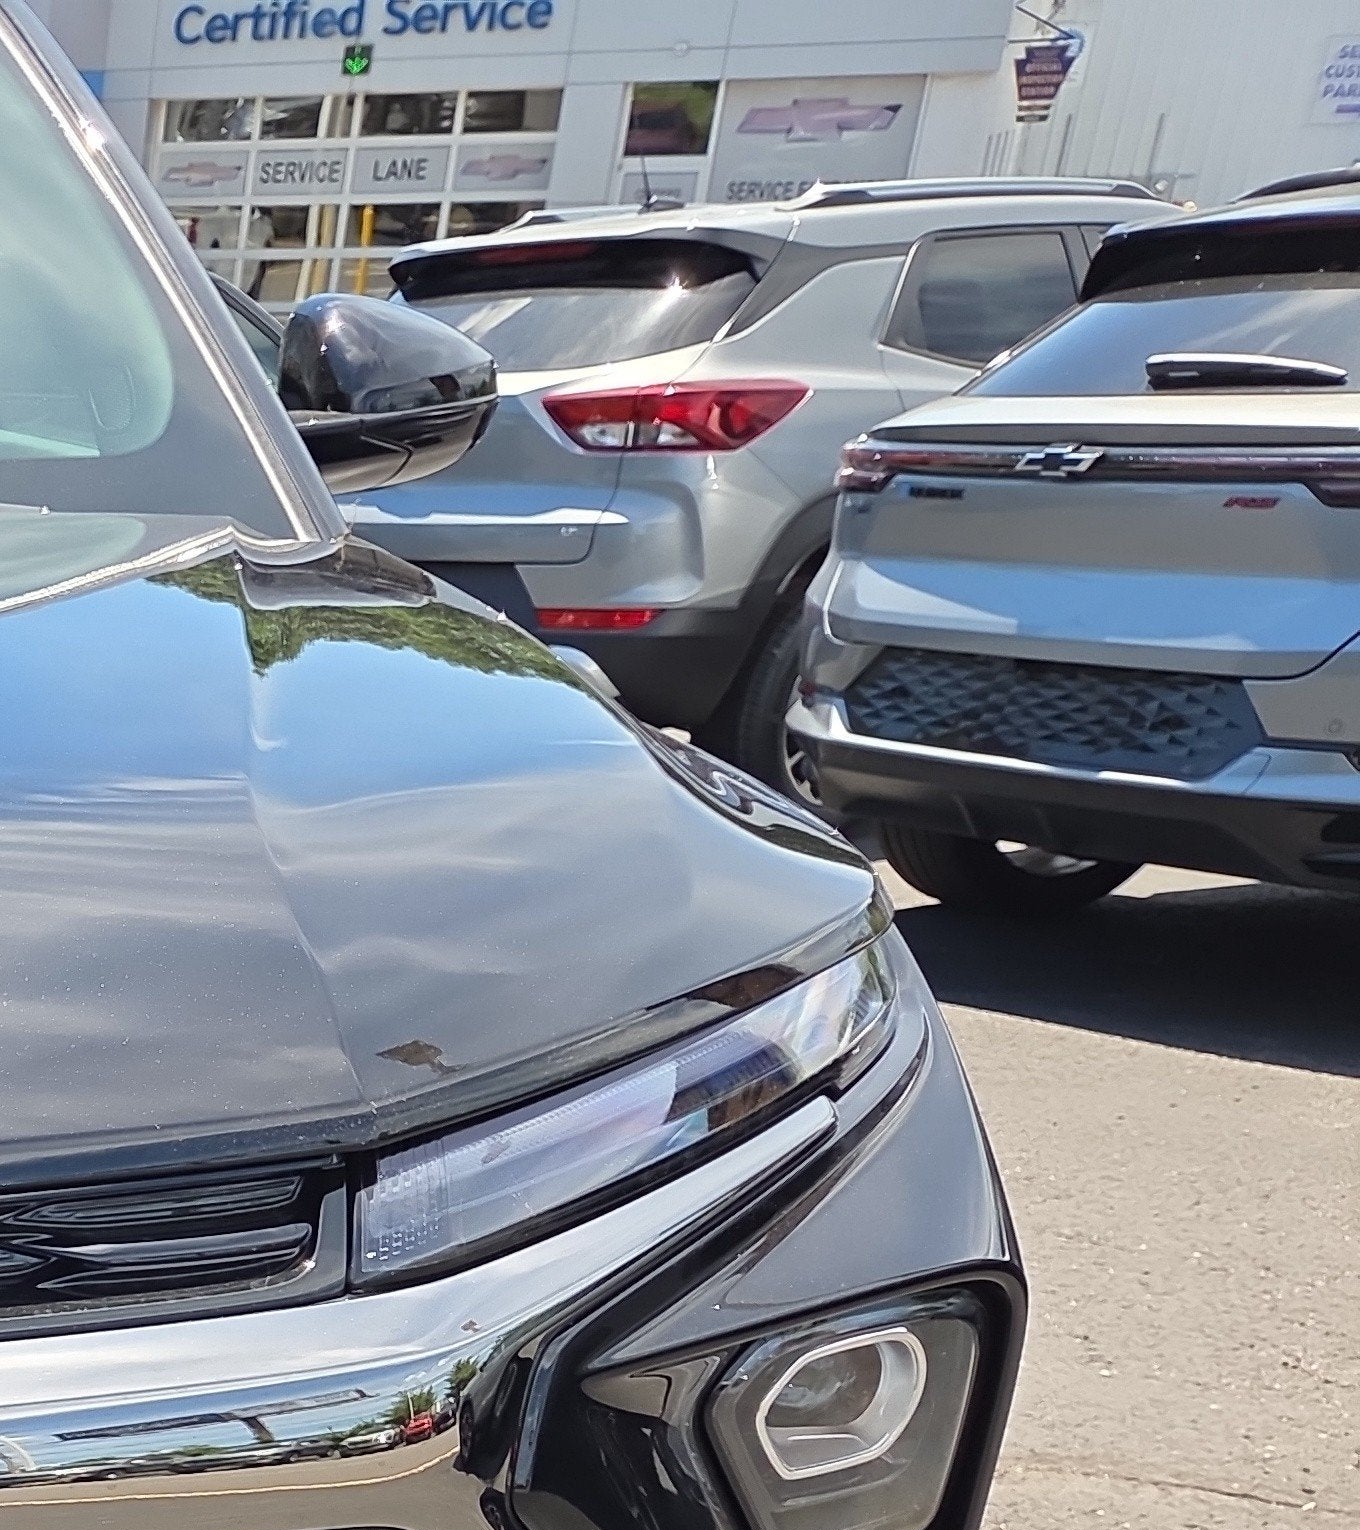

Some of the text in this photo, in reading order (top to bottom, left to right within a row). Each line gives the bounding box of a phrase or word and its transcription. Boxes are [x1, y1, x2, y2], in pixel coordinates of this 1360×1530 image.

[174, 0, 553, 44] Certified Service
[1326, 64, 1360, 78] CUS
[259, 157, 429, 184] SERVICE LANE
[726, 180, 795, 201] SERVICE
